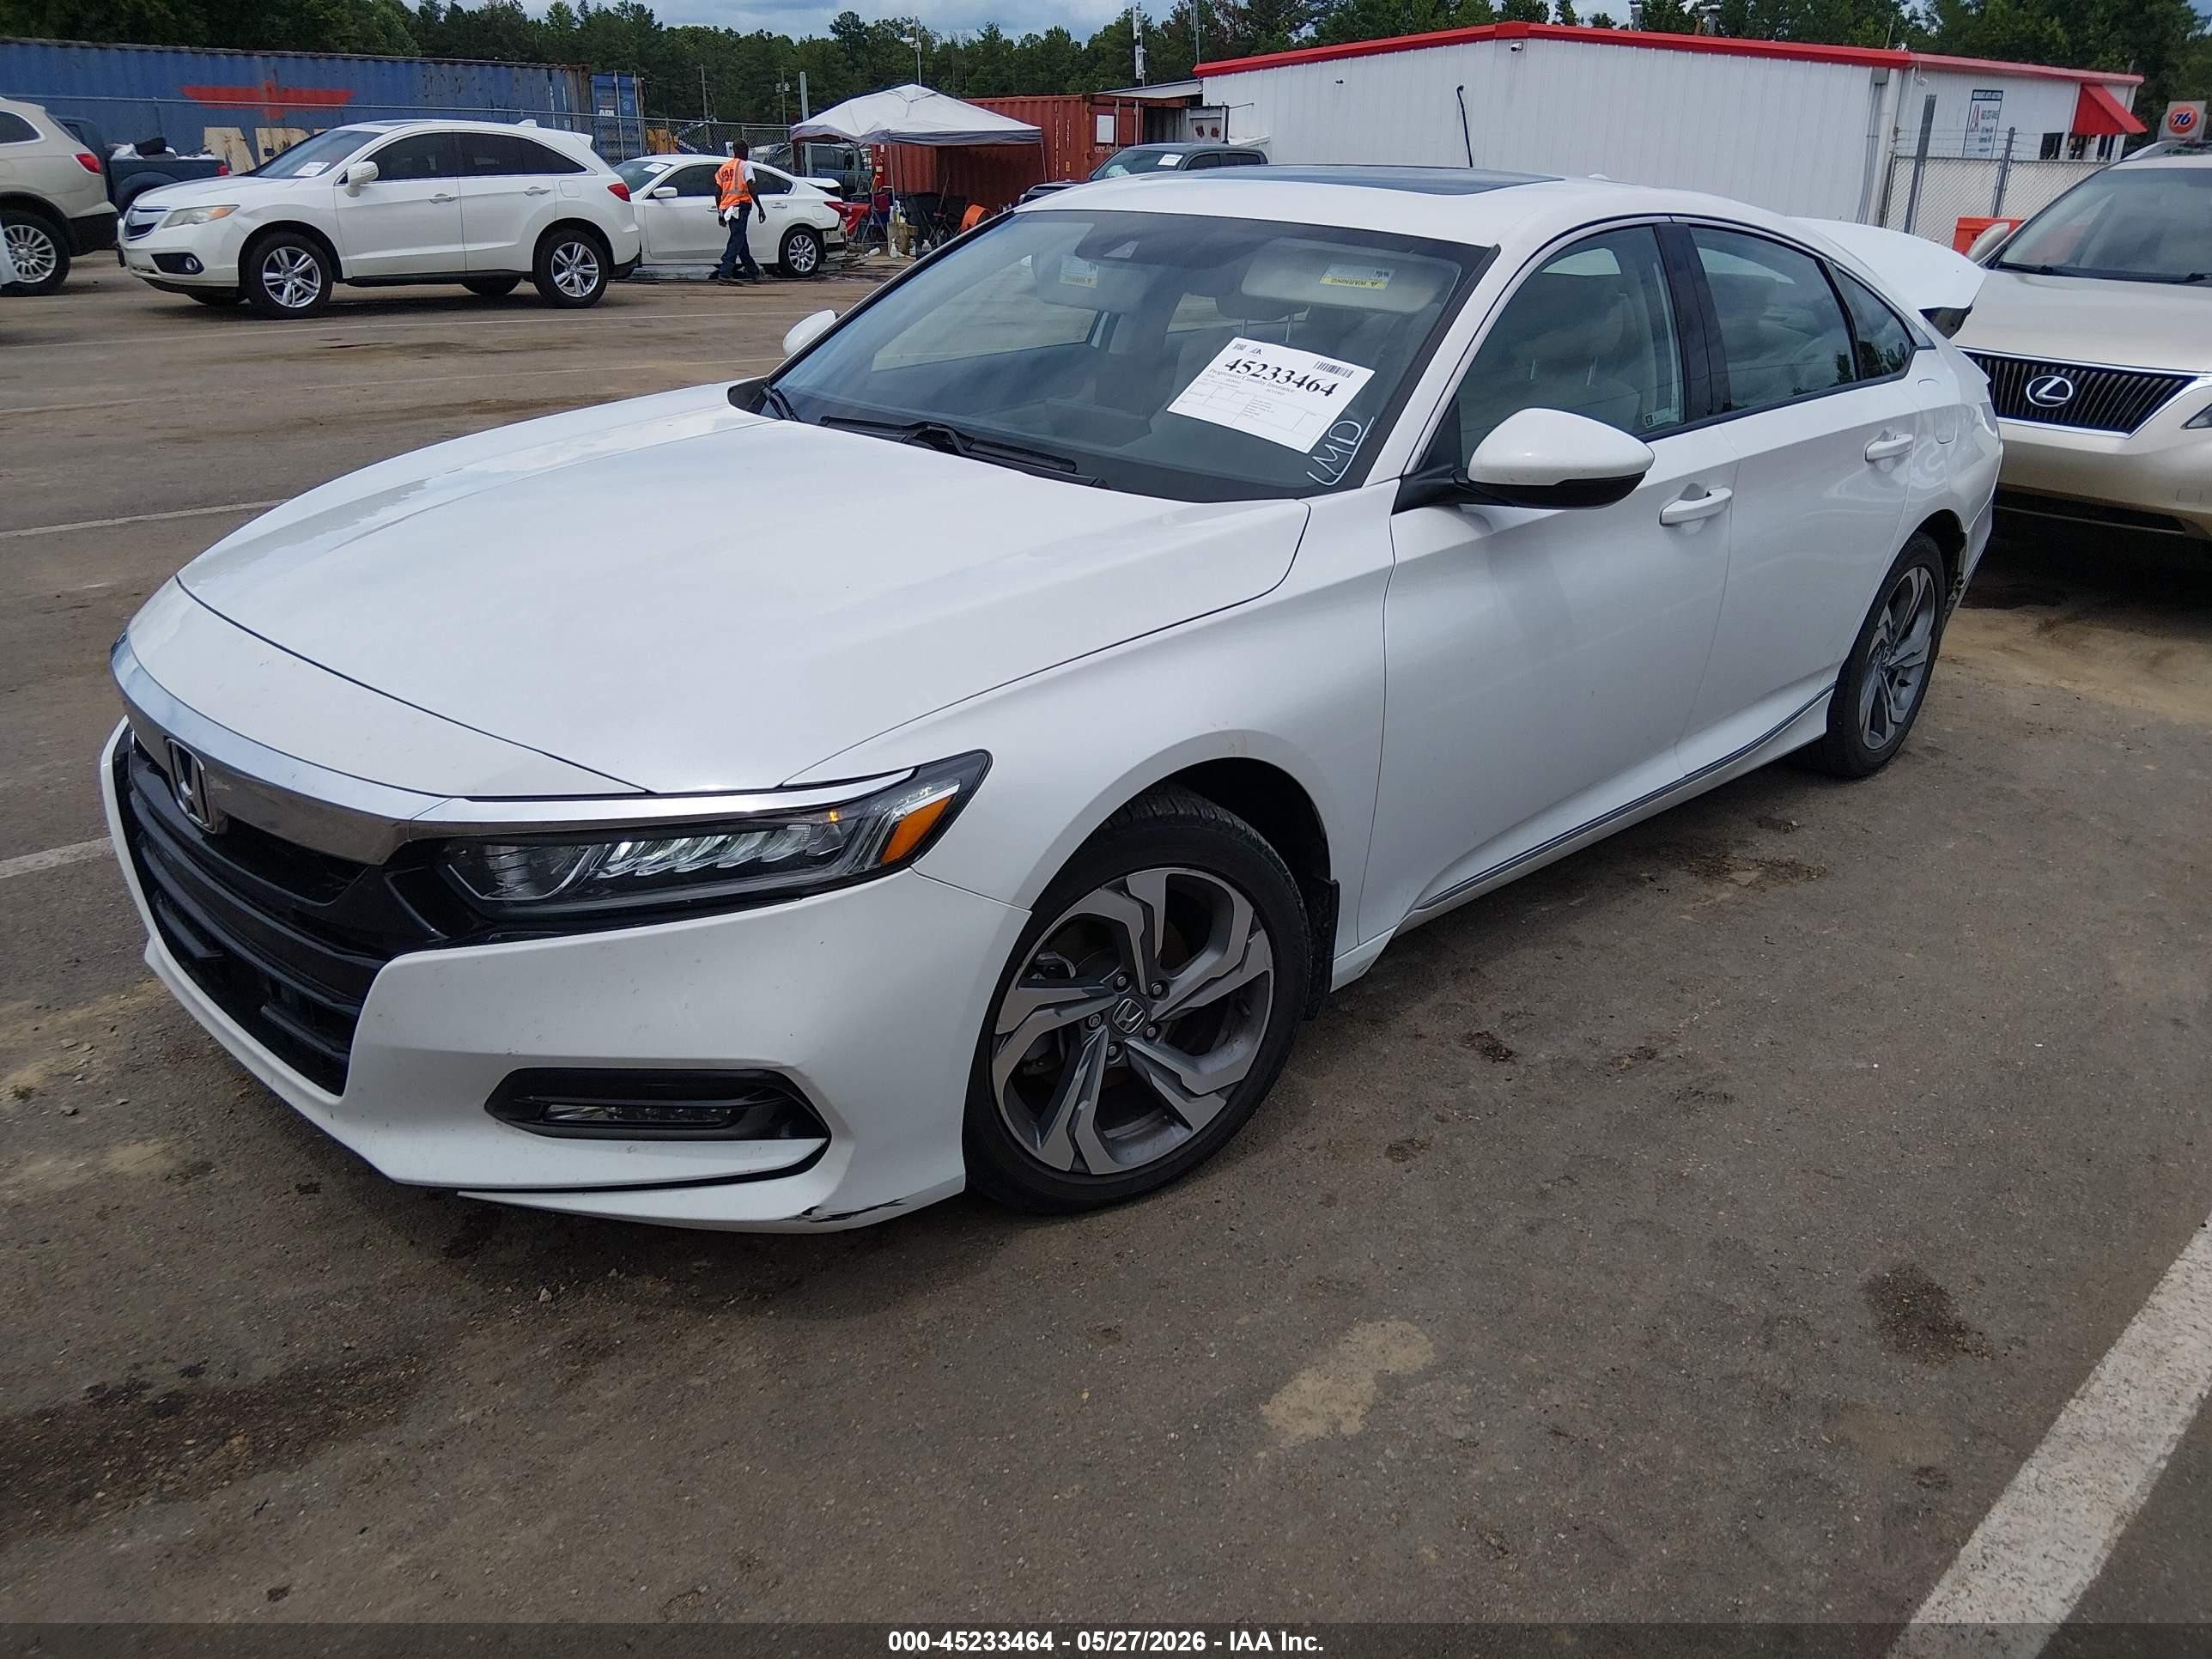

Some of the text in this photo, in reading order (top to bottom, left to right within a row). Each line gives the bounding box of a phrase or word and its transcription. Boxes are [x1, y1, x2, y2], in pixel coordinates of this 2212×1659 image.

[2172, 112, 2191, 126] 76
[204, 126, 325, 176] AP
[1224, 358, 1339, 397] 45233464
